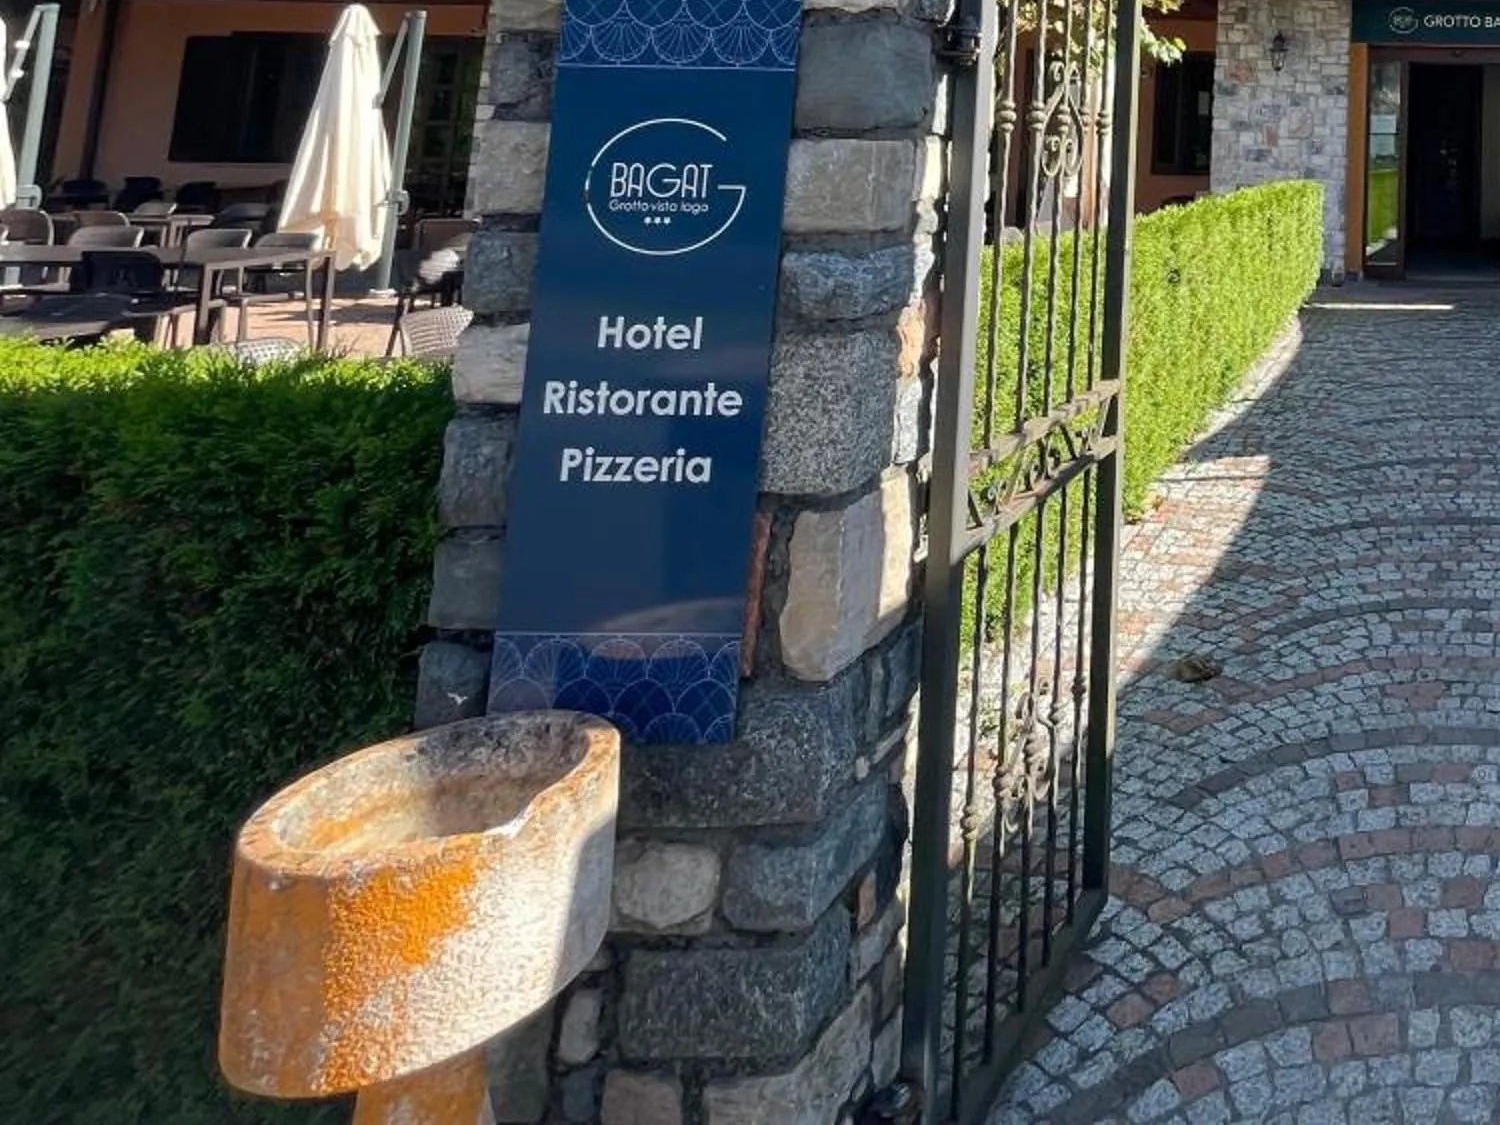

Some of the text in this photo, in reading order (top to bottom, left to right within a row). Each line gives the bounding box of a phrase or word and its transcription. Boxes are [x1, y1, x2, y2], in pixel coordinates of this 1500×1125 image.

[1423, 14, 1481, 28] GROTTO
[610, 162, 713, 198] BAGAT
[597, 316, 704, 351] Hotel
[543, 381, 743, 416] Ristorante
[559, 448, 712, 483] Pizzeria
